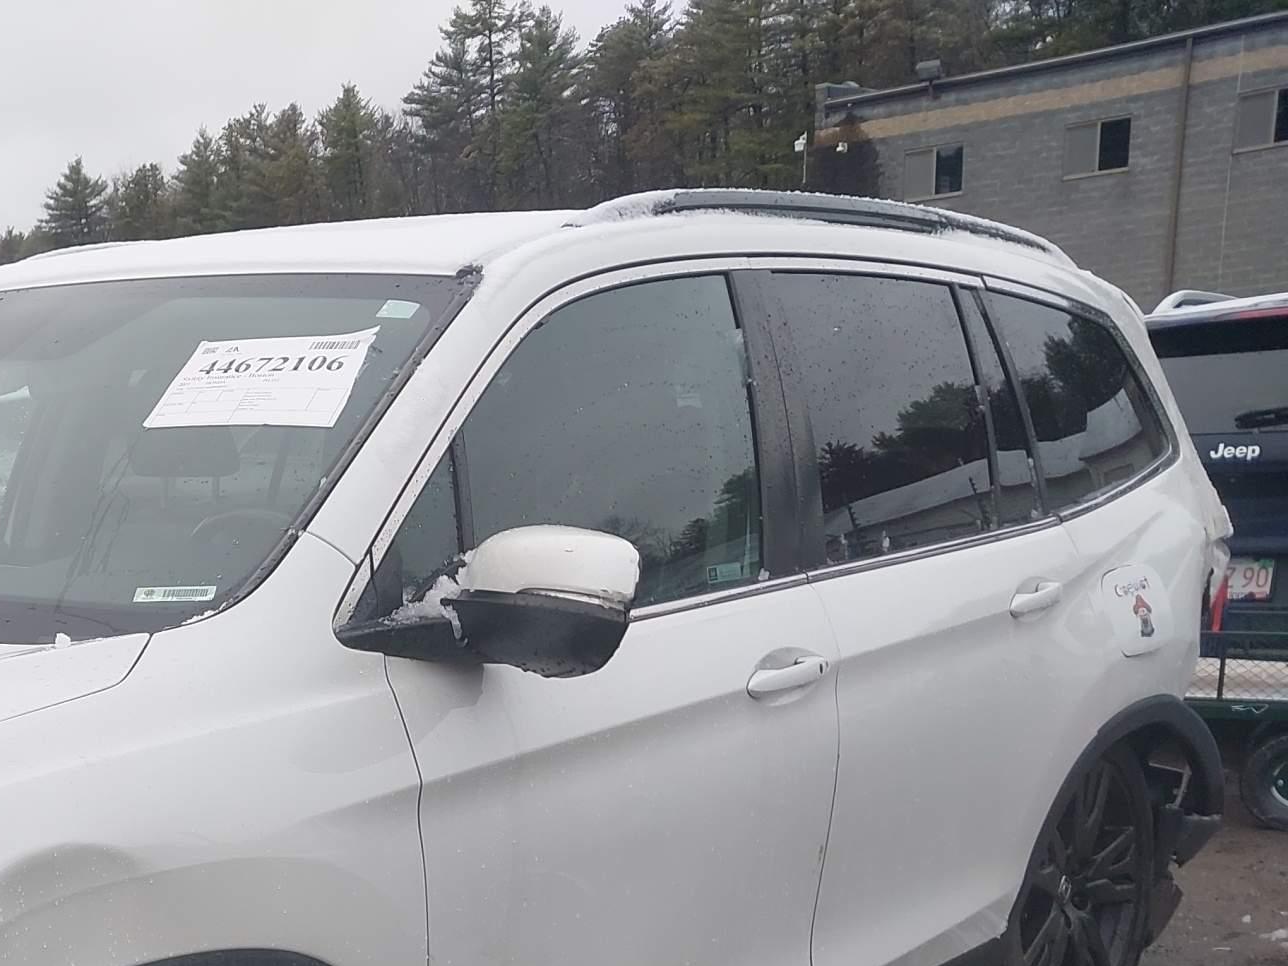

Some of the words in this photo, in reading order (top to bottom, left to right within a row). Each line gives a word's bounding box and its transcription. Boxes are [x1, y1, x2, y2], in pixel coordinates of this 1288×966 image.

[199, 354, 348, 375] 44672106
[1209, 443, 1261, 461] Jeep
[1243, 566, 1269, 588] 90
